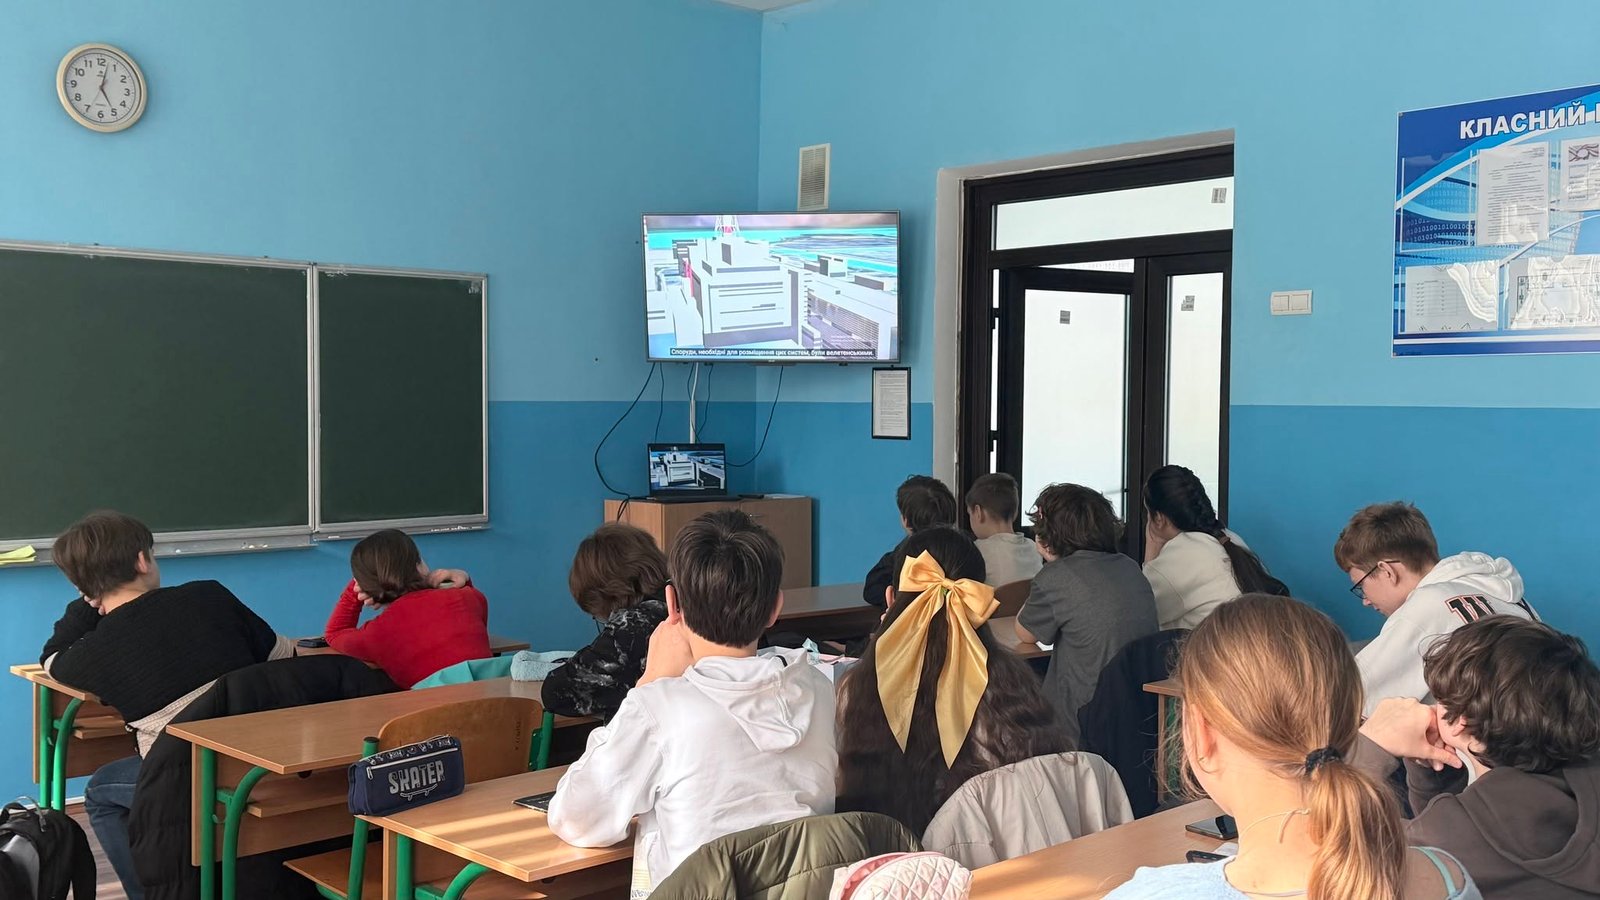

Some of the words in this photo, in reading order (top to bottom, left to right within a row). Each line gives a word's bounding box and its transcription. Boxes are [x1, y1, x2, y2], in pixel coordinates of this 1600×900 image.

[84, 59, 92, 68] 11
[97, 58, 106, 67] 12
[75, 68, 85, 77] 10
[120, 75, 127, 83] 2
[70, 80, 77, 88] 9
[124, 88, 130, 96] 3
[74, 93, 82, 101] 8
[84, 104, 91, 112] 7
[119, 100, 126, 108] 4
[97, 110, 104, 118] 6
[111, 108, 117, 116] 5
[1460, 101, 1586, 139] КЛАСНИЙ
[671, 348, 697, 356] Споруди,
[388, 760, 445, 794] SKATER
